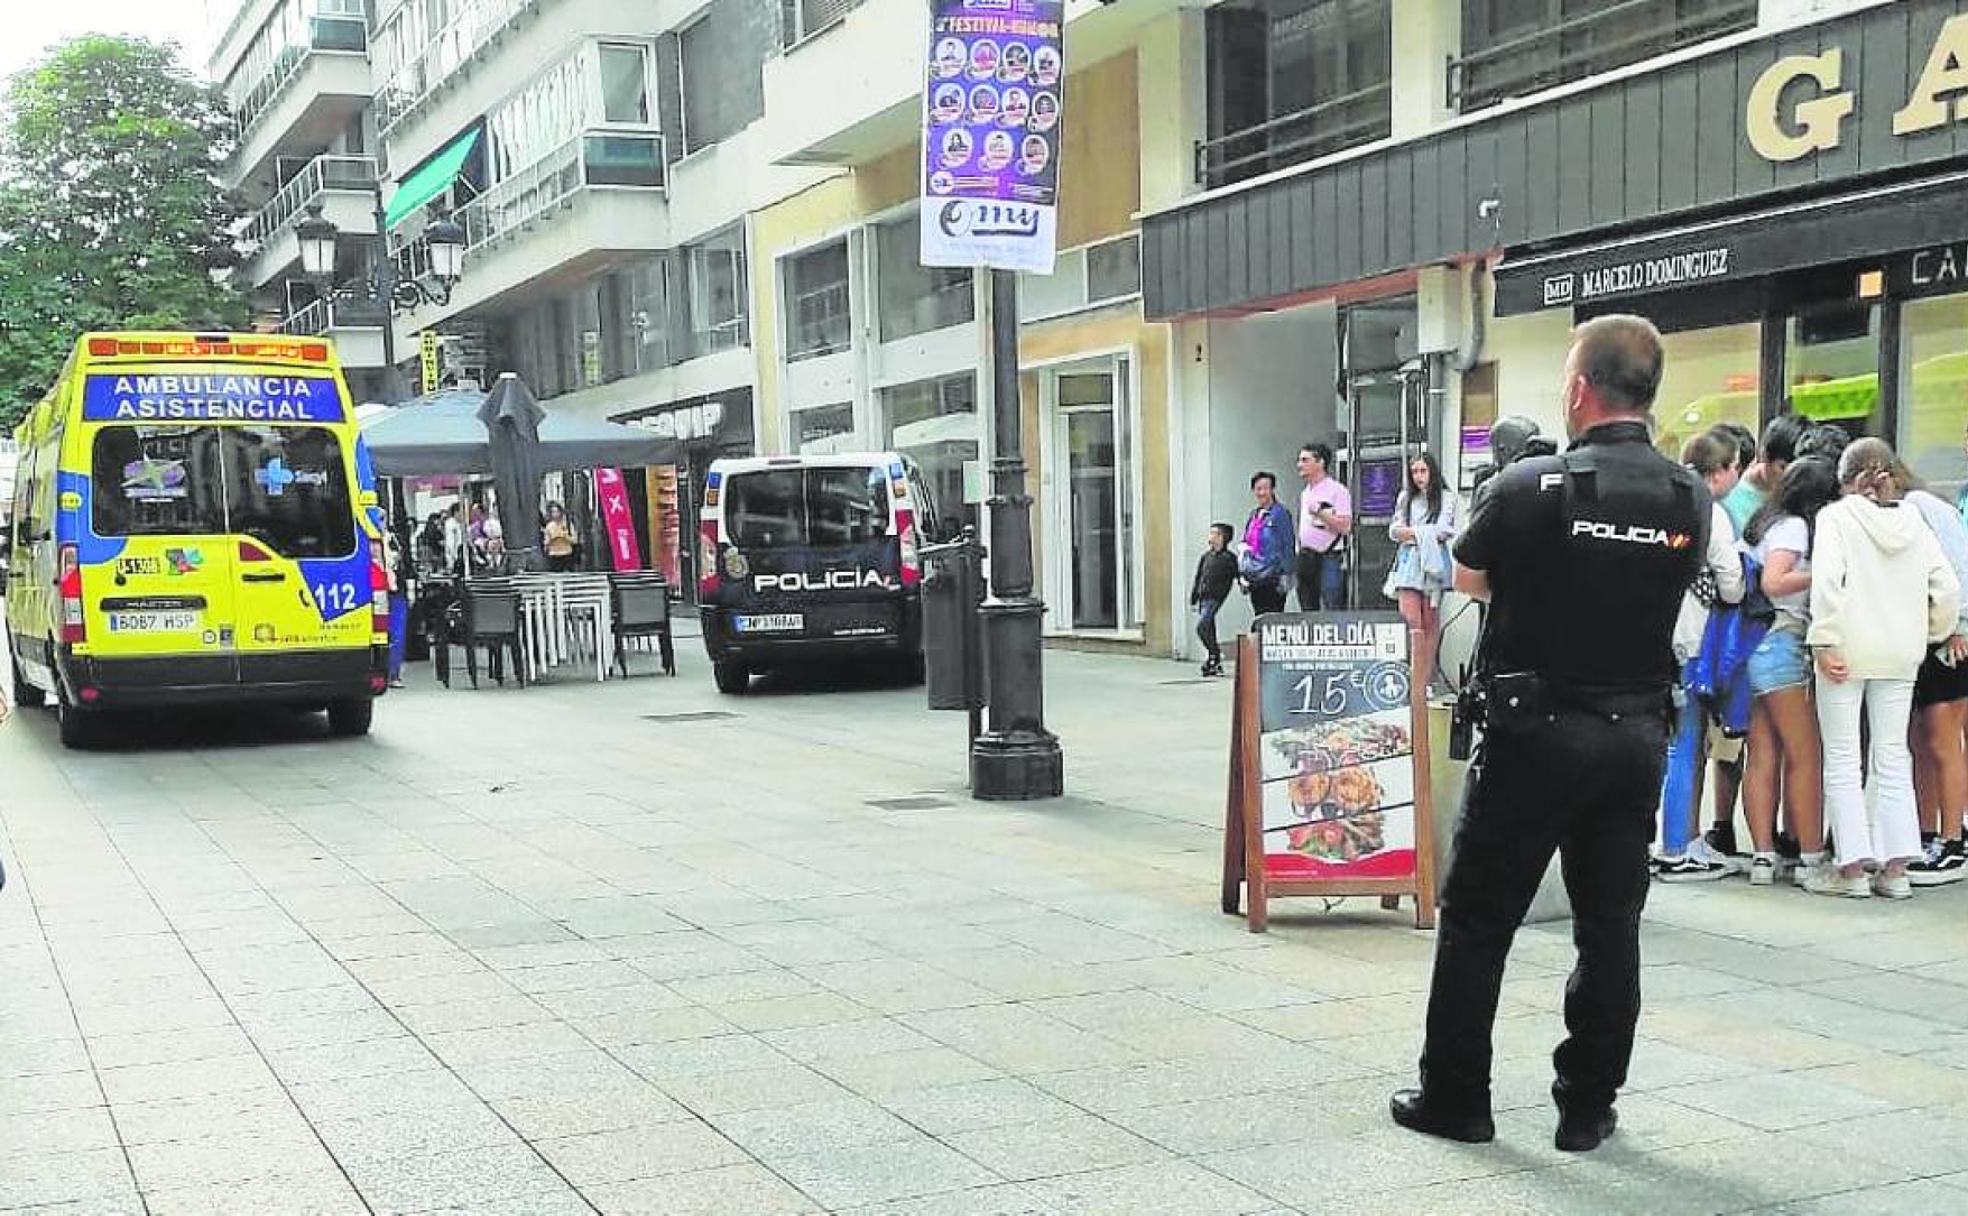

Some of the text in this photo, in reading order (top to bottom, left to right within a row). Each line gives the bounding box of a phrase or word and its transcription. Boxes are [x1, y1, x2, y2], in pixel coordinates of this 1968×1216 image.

[1582, 263, 1643, 298] MARCELO
[1645, 249, 1728, 287] DOMINGUEZ
[114, 375, 312, 398] AMBULANCIA
[115, 399, 314, 420] ASISTENCIAL
[1571, 520, 1669, 547] POLICIA
[315, 582, 356, 610] 112
[1262, 620, 1309, 645] MENÚ
[1313, 624, 1344, 645] DEL
[1347, 620, 1374, 645] DÍA
